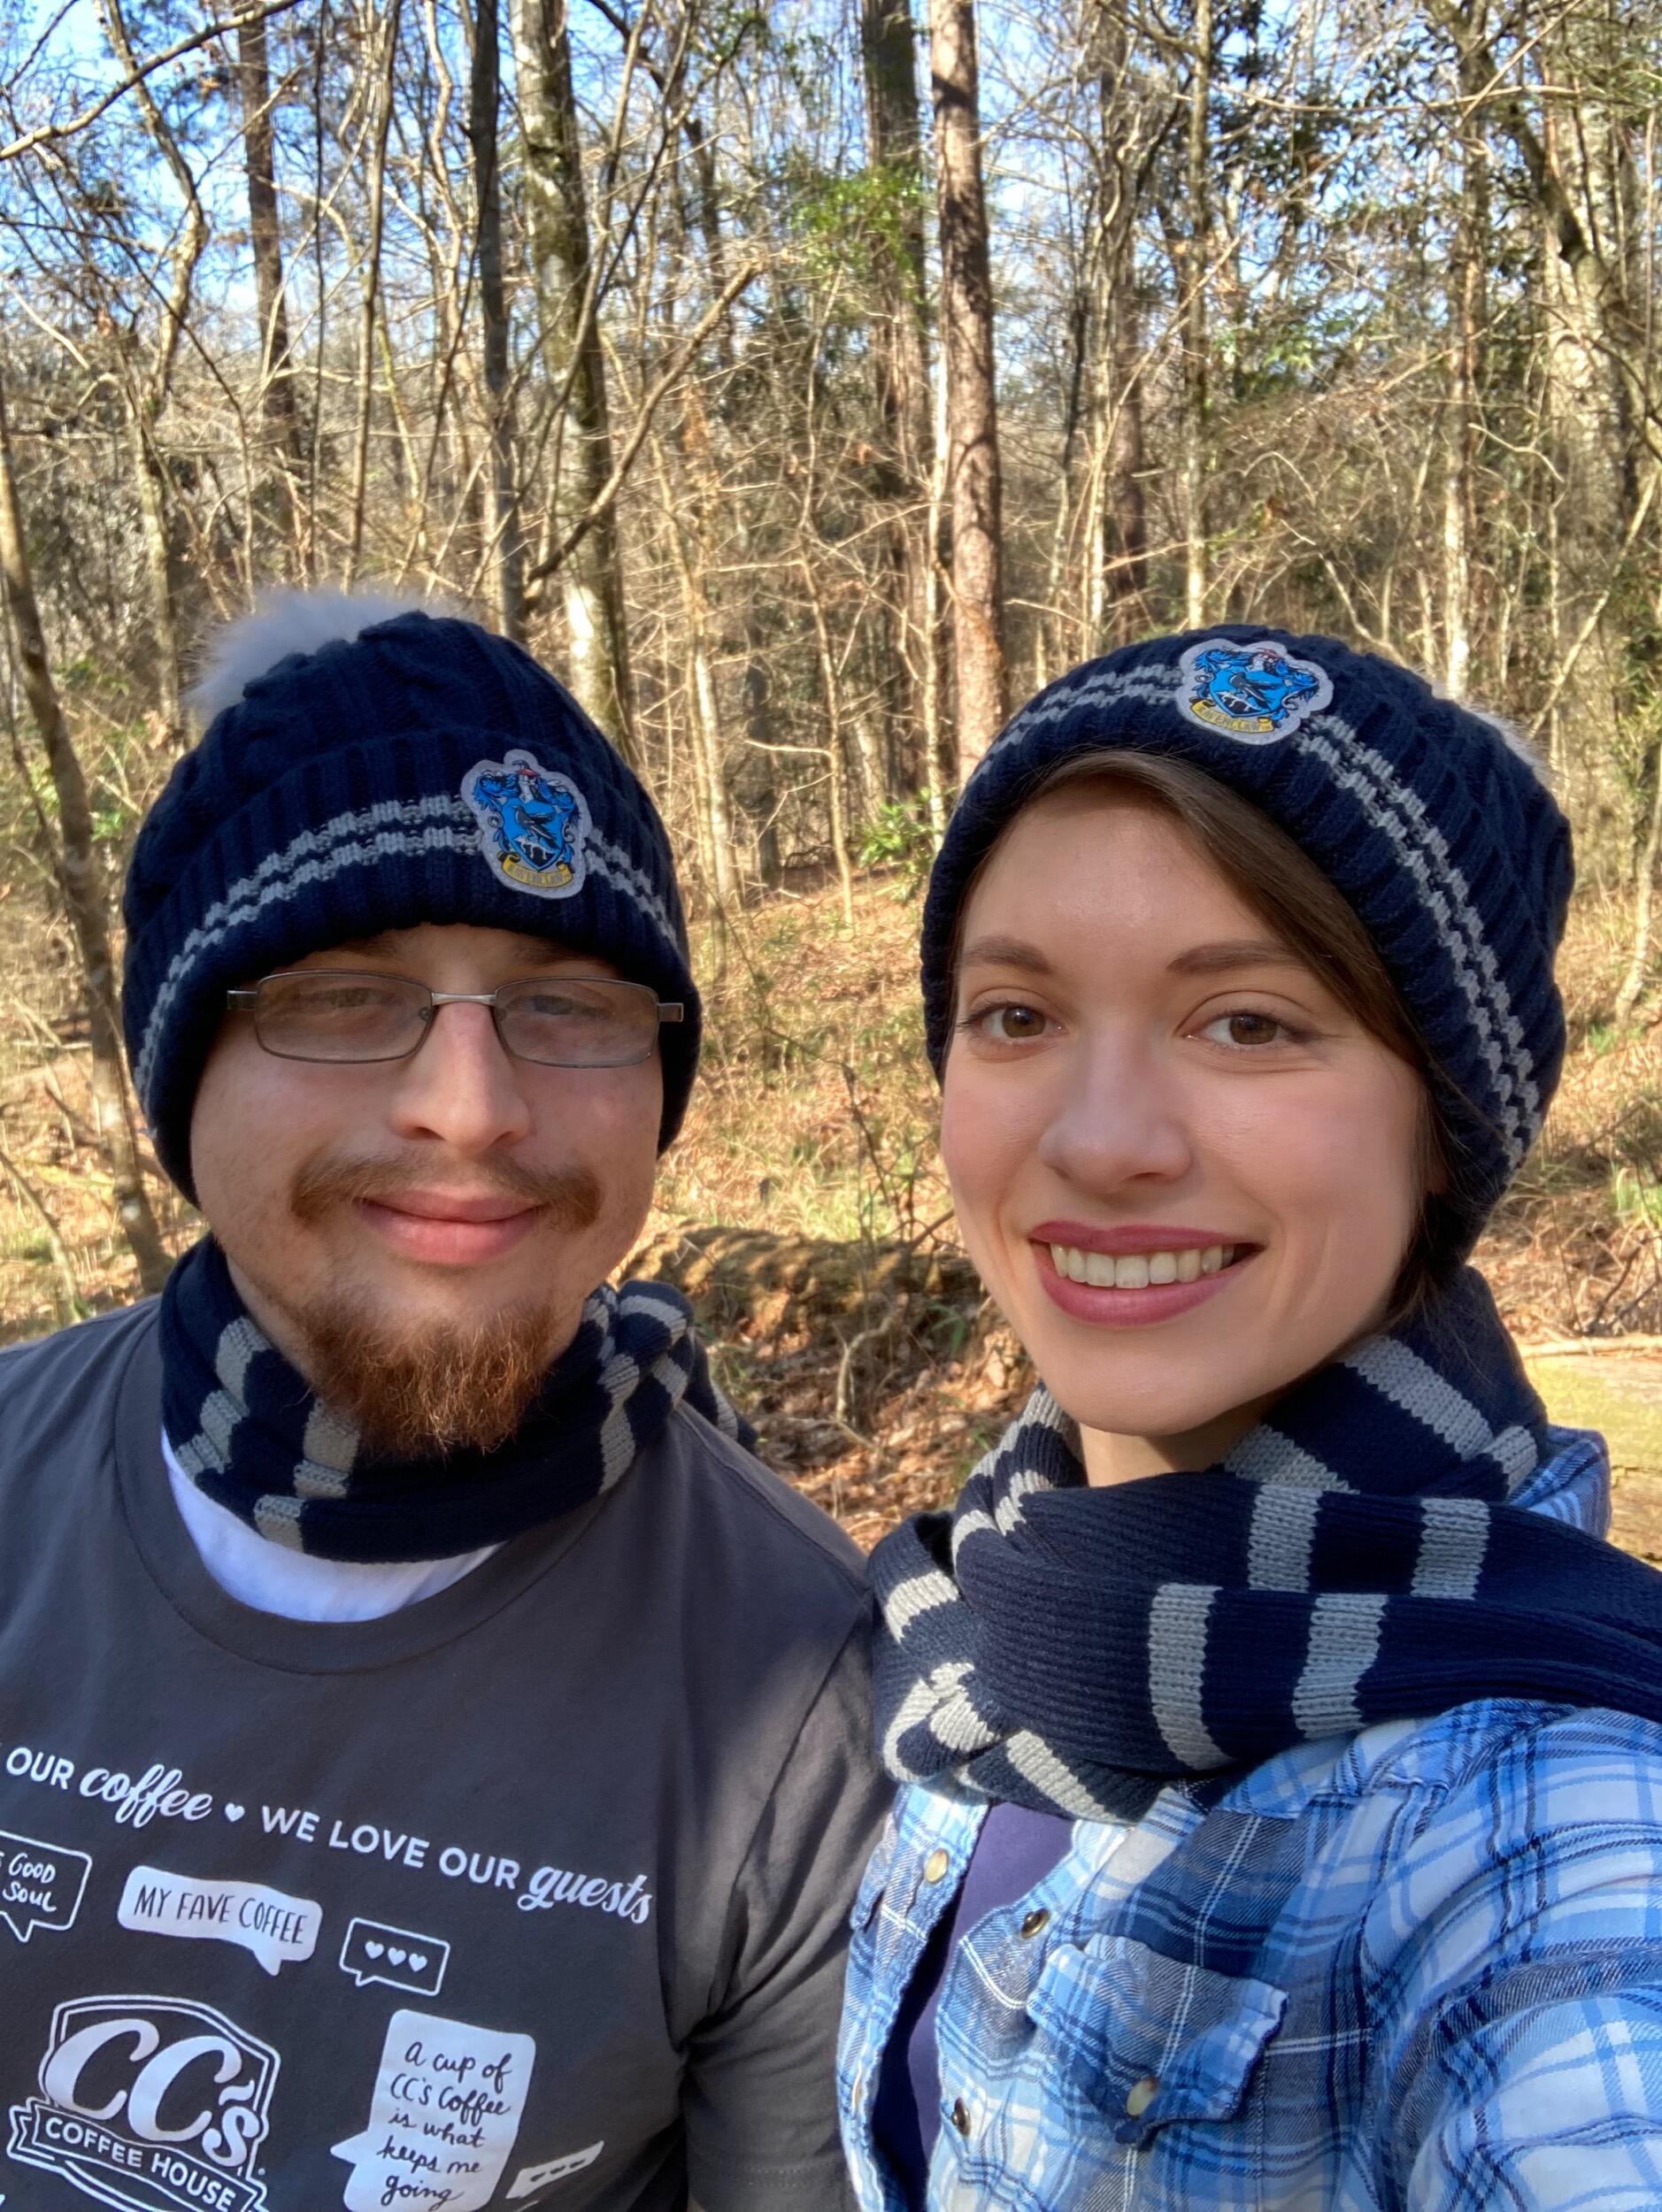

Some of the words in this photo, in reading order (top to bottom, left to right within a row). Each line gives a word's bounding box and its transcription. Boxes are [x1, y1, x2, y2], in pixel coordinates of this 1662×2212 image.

[6, 1747, 75, 1789] OUR
[80, 1764, 212, 1828] coffee
[262, 1806, 319, 1842] WE
[328, 1820, 430, 1868] LOVE
[439, 1847, 520, 1889] OUR
[517, 1866, 653, 1924] guests
[134, 1885, 173, 1917] MY
[177, 1893, 235, 1923] FAVE
[239, 1898, 308, 1944] COFFEE
[433, 2053, 476, 2083] cup
[481, 2053, 512, 2093] of
[389, 2108, 417, 2128] is
[424, 2123, 485, 2148] what
[45, 2117, 142, 2168] COFFEE
[150, 2153, 236, 2212] HOUSE
[376, 2135, 442, 2176] keeps
[447, 2159, 481, 2174] me
[381, 2175, 465, 2212] going
